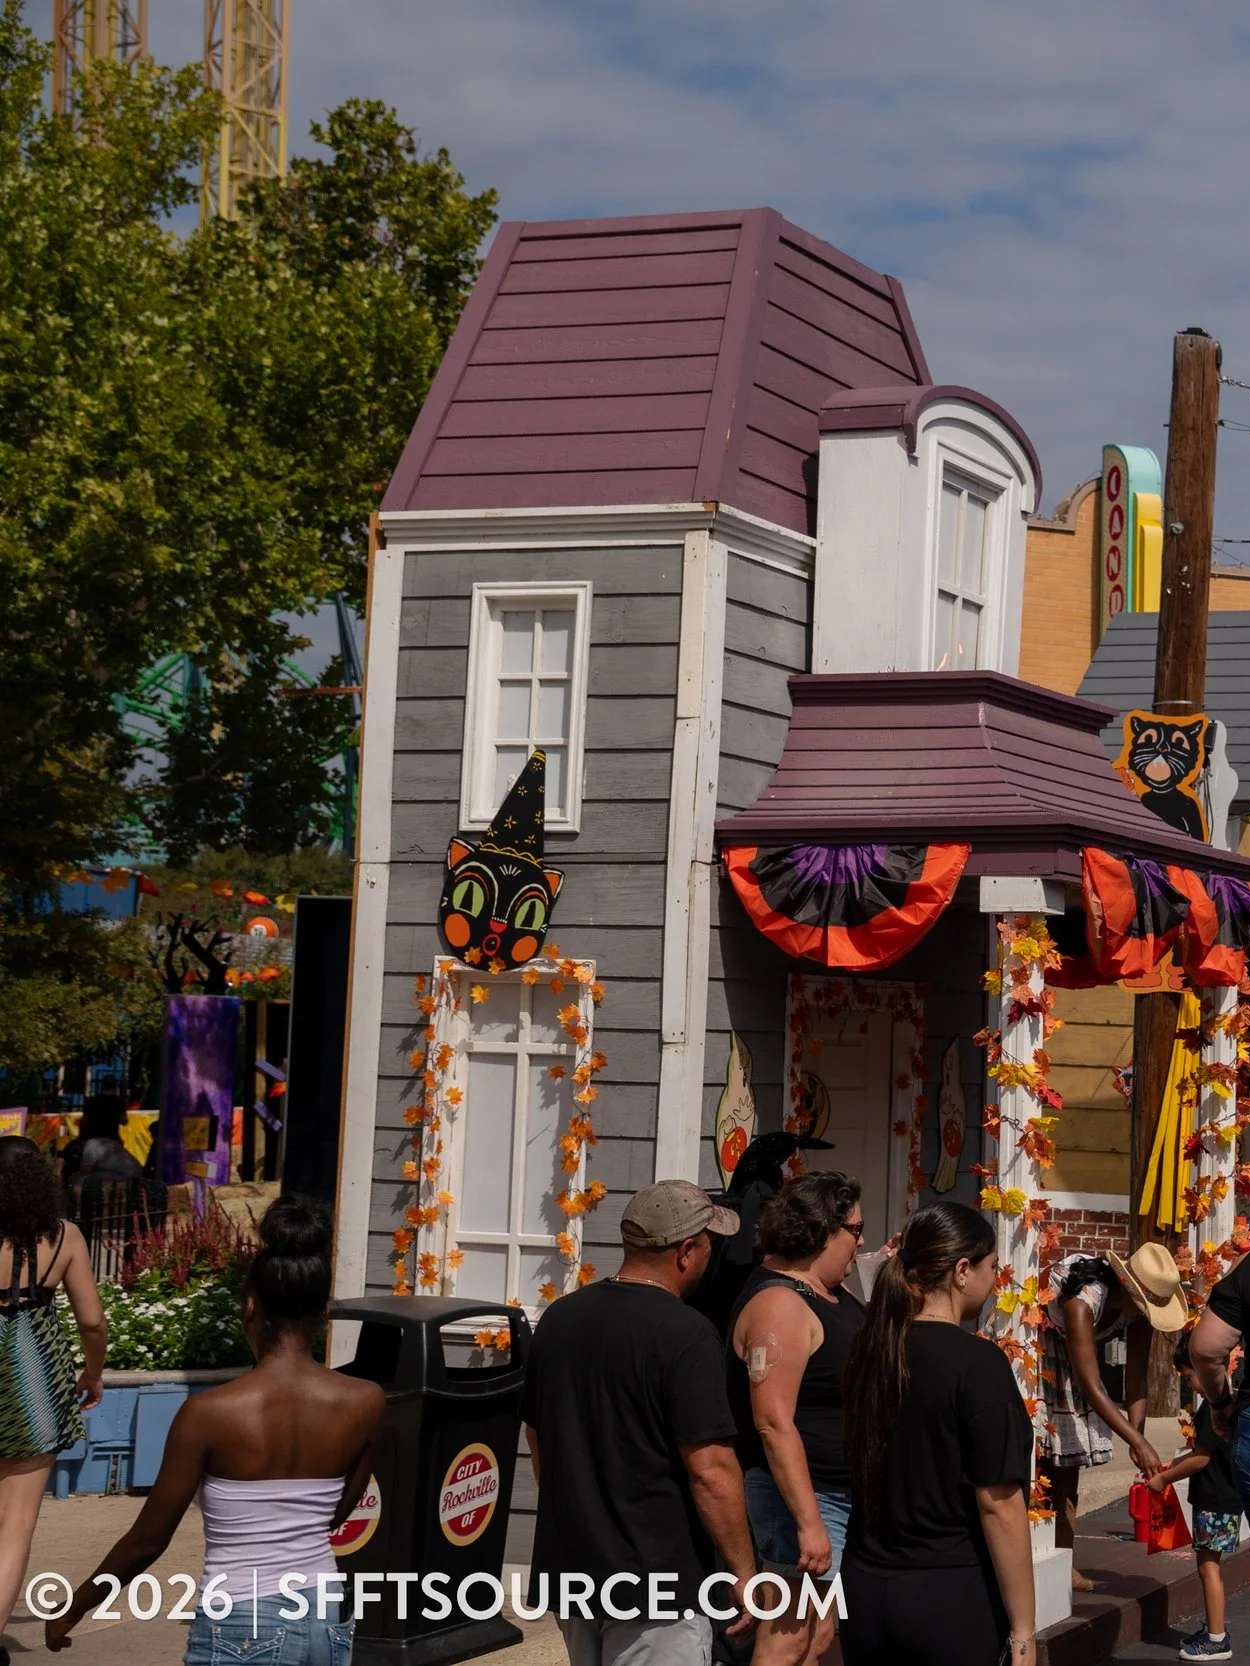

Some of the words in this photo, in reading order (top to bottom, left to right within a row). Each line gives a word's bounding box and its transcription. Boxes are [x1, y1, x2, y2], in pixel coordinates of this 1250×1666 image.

[456, 1459, 484, 1480] CITY
[442, 1475, 498, 1514] Rockville
[461, 1511, 477, 1528] OF
